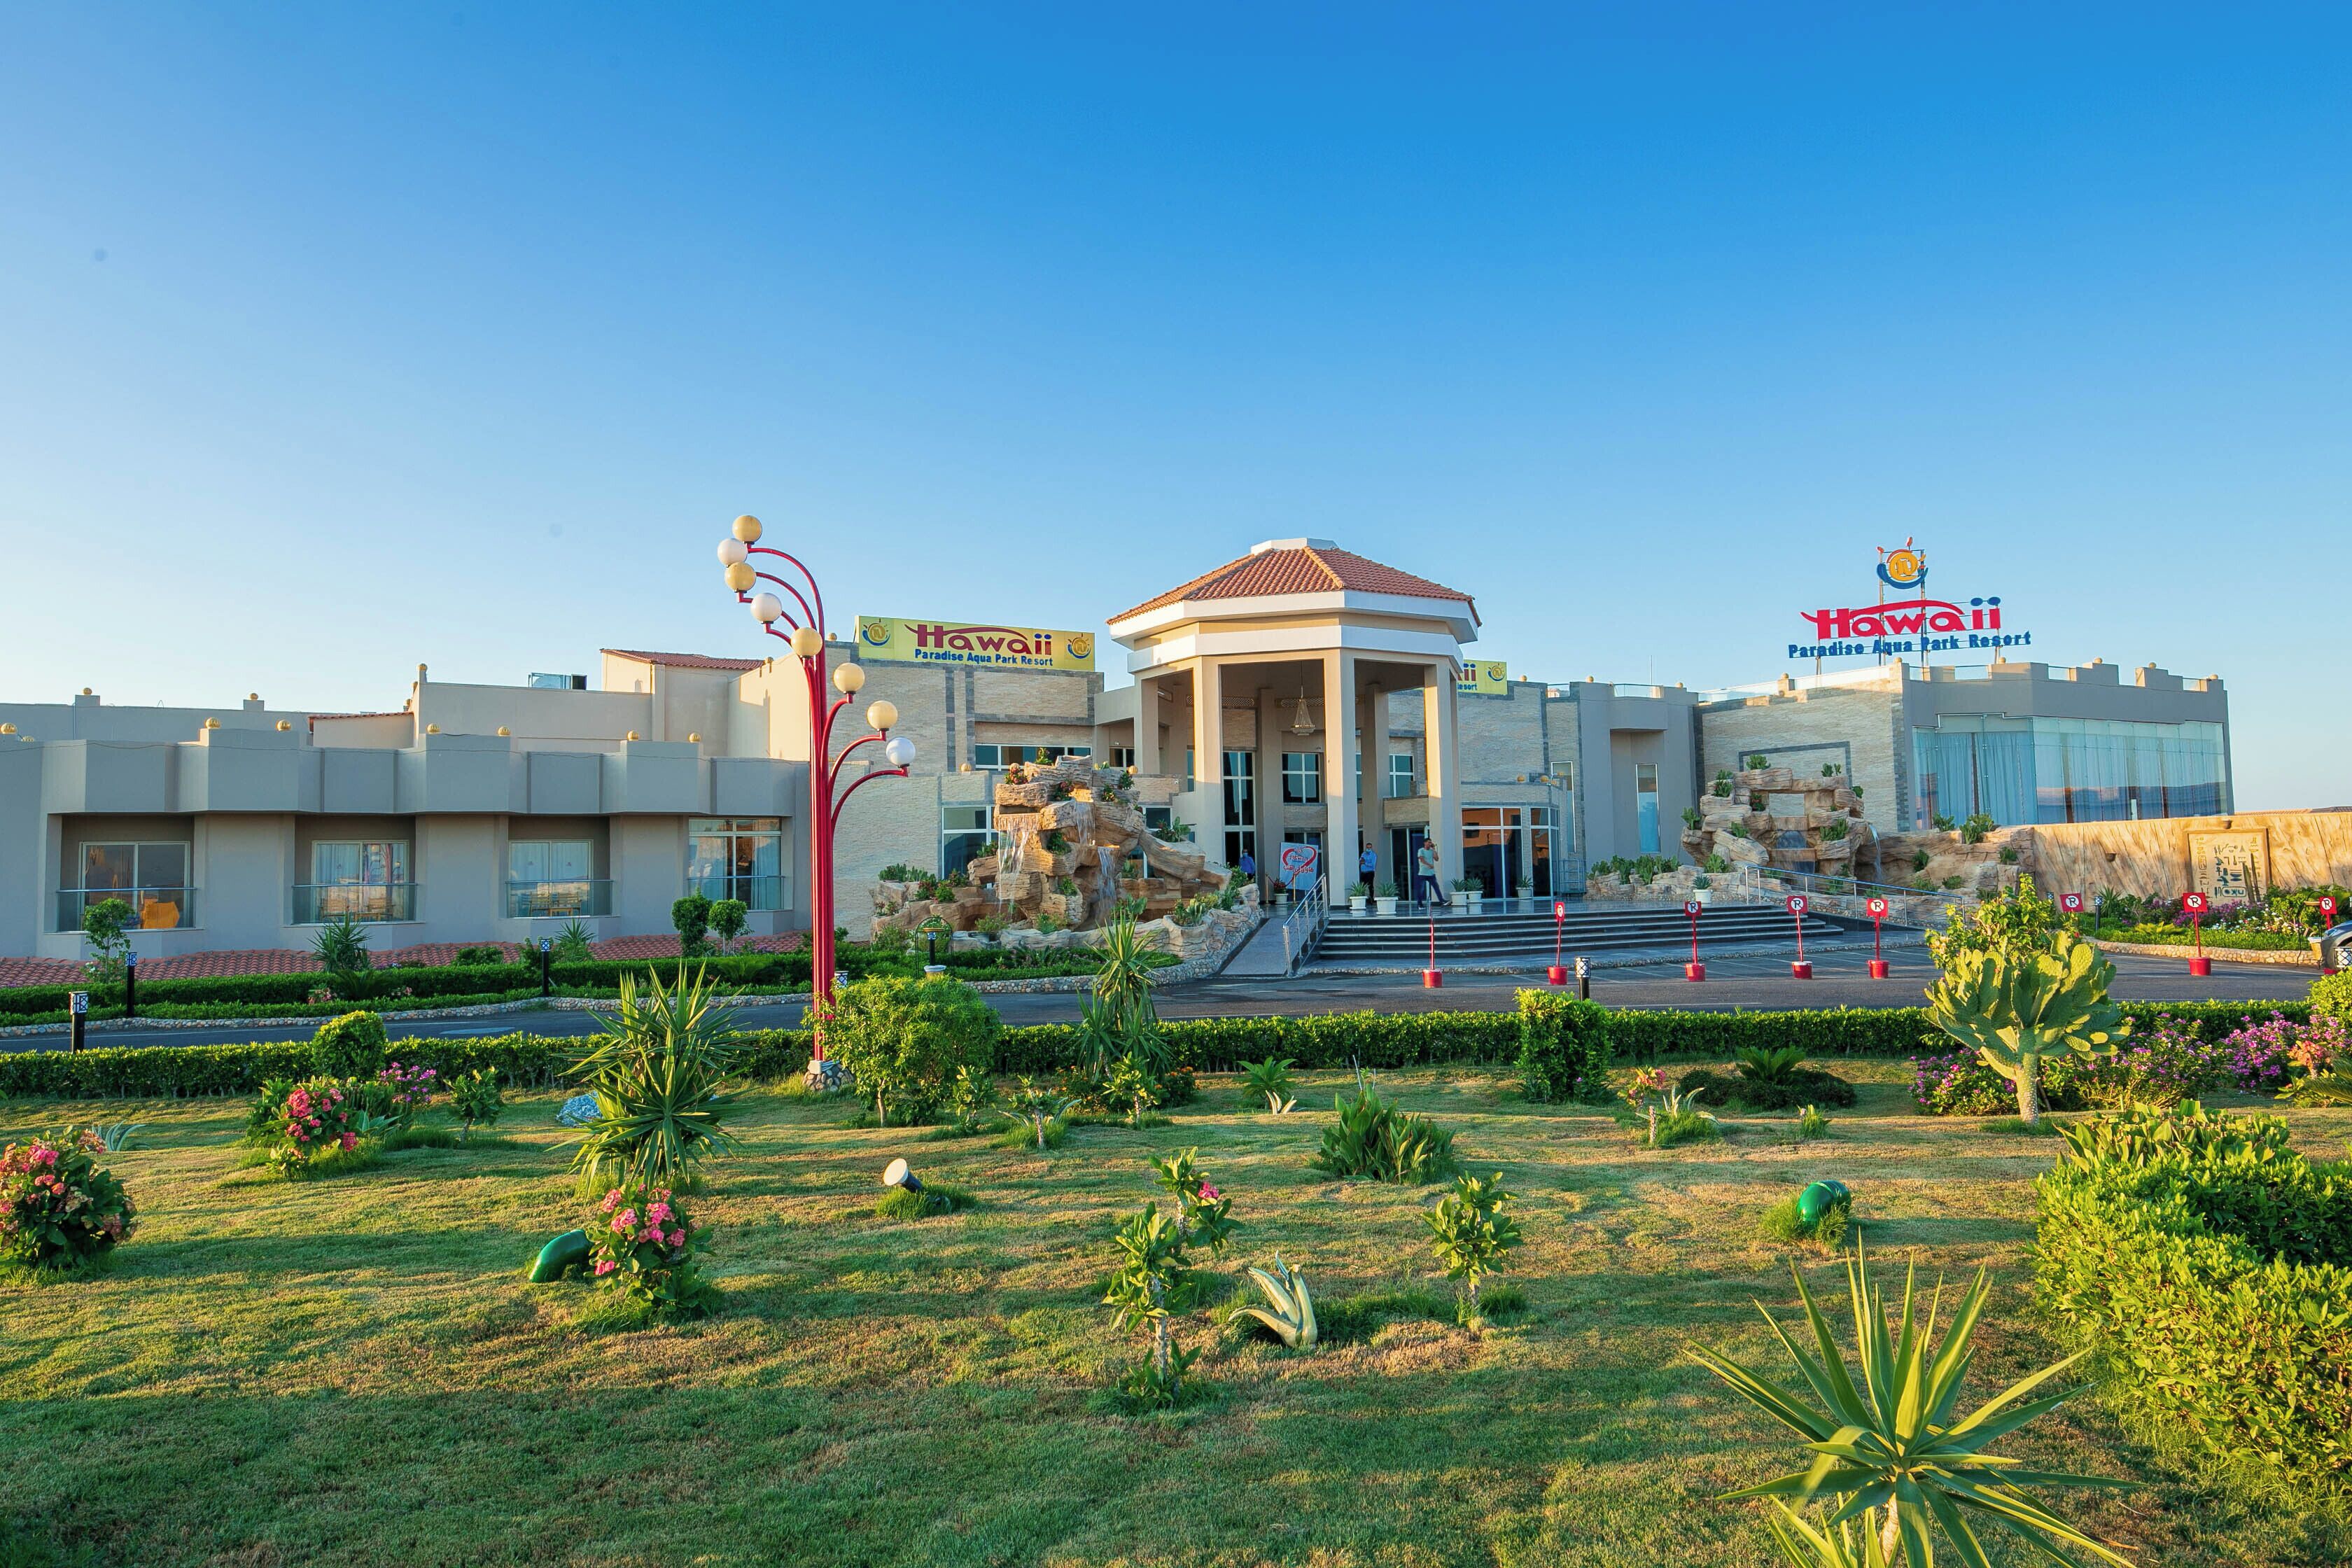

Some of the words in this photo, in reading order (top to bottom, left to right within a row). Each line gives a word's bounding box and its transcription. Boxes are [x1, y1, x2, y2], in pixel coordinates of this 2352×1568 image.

[1800, 596, 2001, 640] Hawaii
[904, 624, 1052, 655] Hawaii
[1788, 641, 1864, 659] Paradise
[1872, 639, 1912, 656] Aqua
[1921, 636, 1959, 651] Park
[1968, 631, 2031, 648] Resort
[915, 649, 964, 662] Paradise
[967, 652, 992, 664] Aqua
[995, 654, 1017, 664] Park
[1021, 655, 1053, 666] Resort
